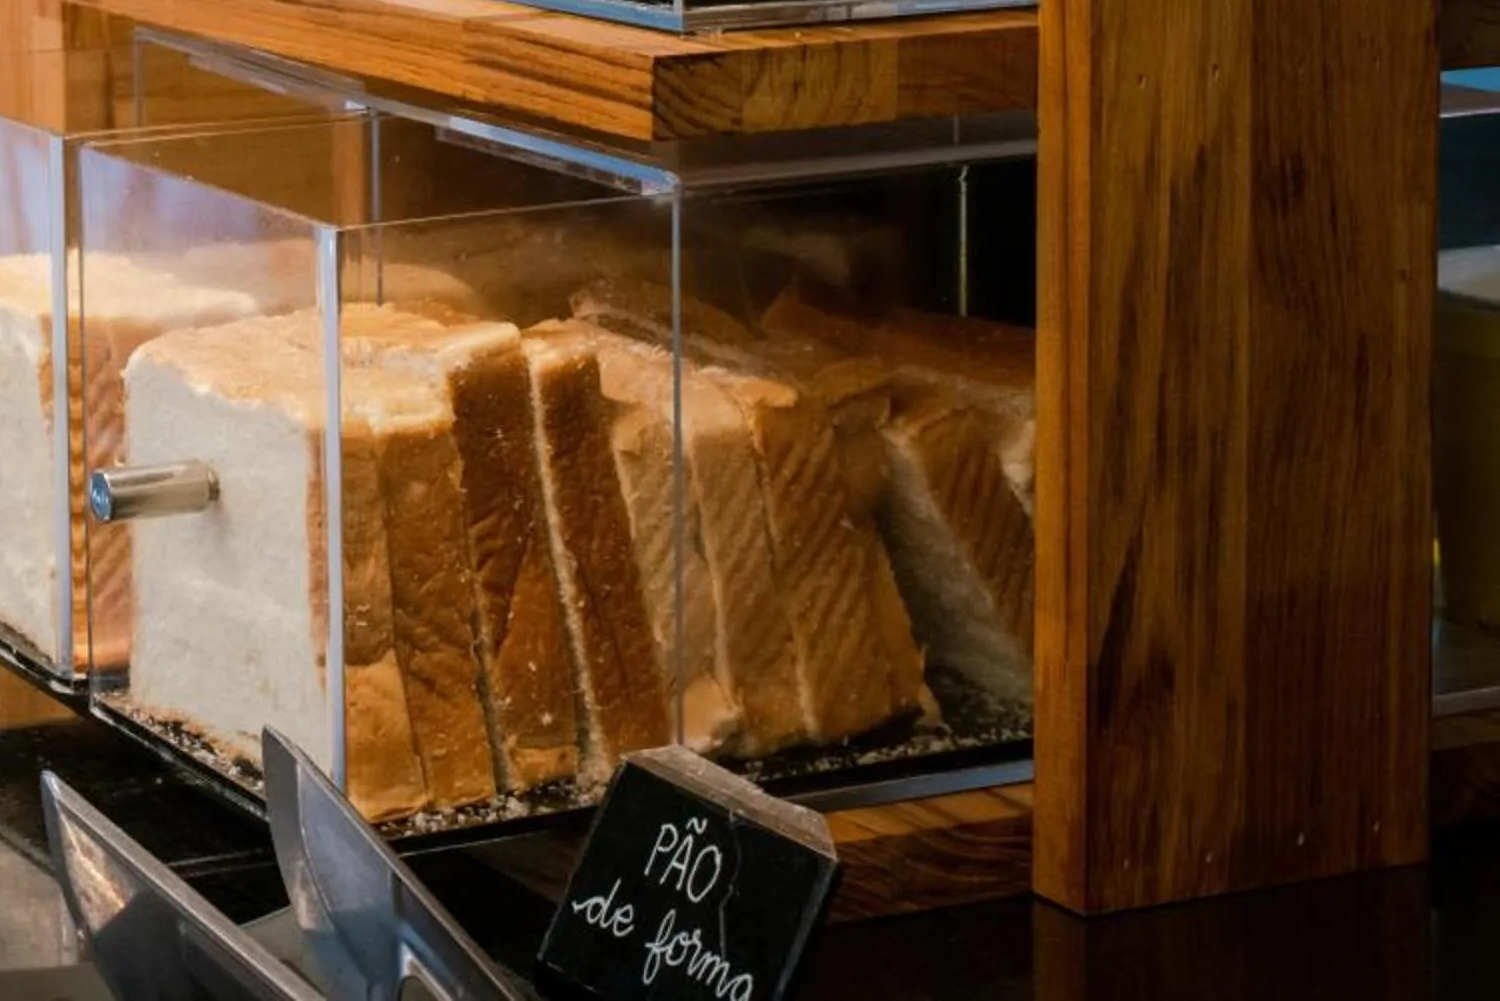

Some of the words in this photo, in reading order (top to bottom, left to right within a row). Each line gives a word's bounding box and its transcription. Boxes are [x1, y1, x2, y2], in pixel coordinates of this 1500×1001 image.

[643, 816, 723, 902] PÃO
[572, 878, 635, 937] de
[642, 908, 753, 1001] forma
